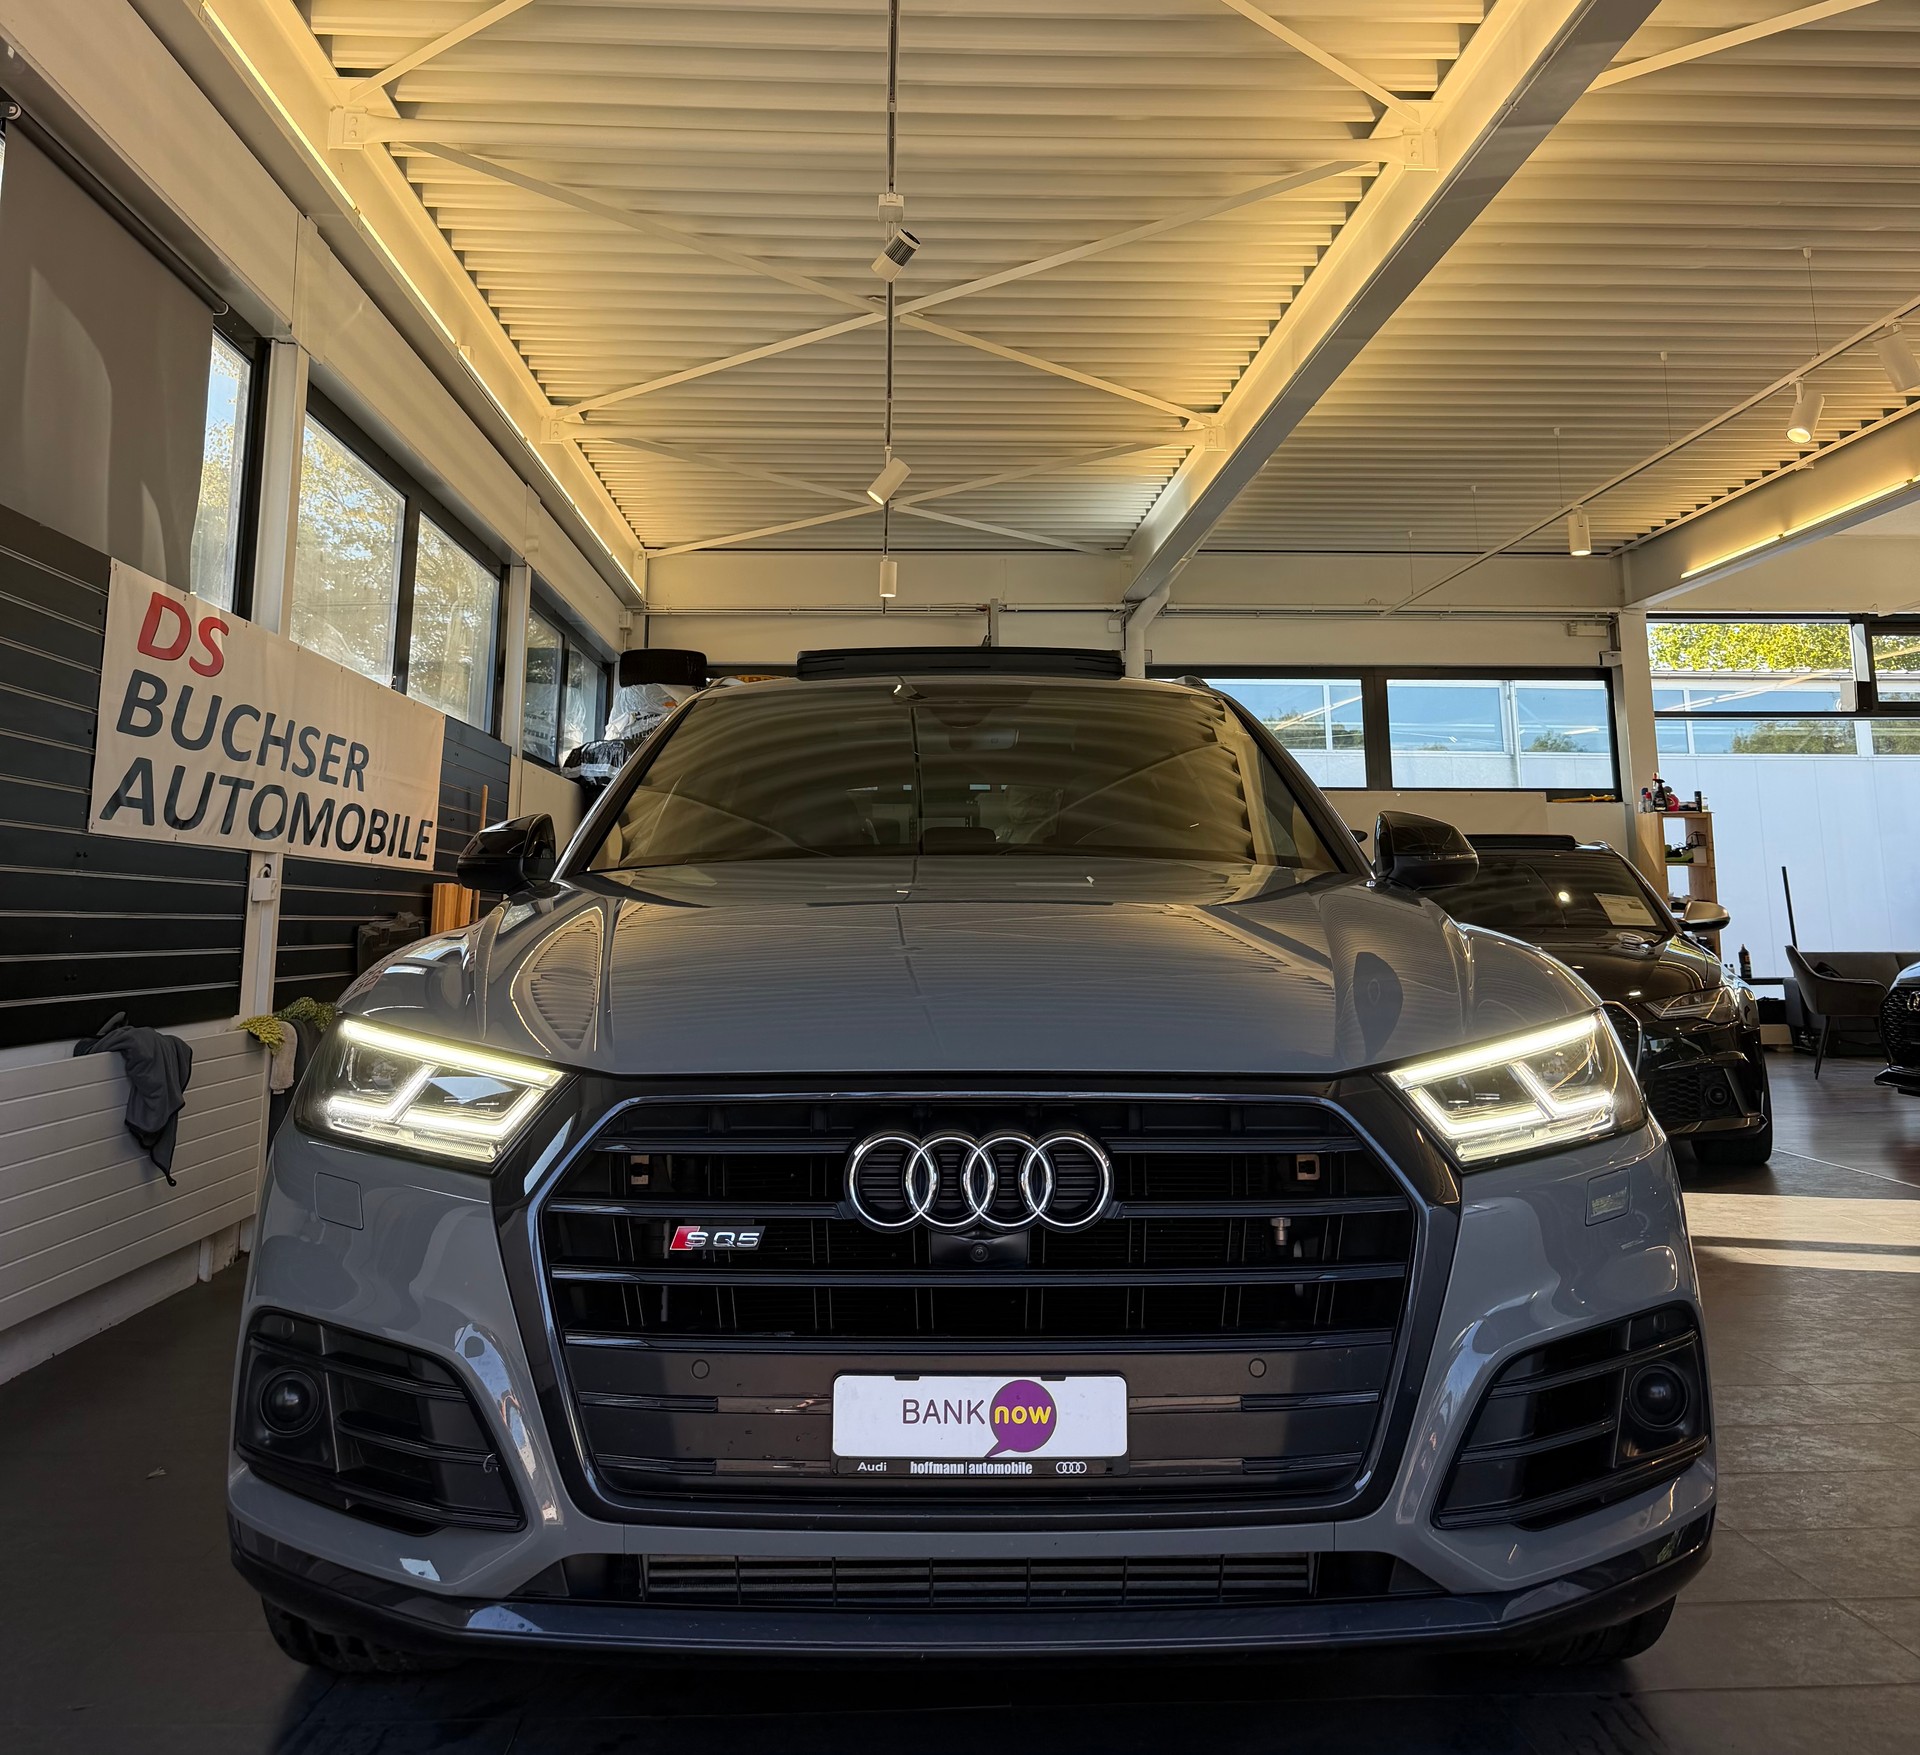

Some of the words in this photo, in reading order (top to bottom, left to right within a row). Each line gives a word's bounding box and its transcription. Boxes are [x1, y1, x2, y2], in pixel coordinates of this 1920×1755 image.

[137, 592, 229, 677] DS
[116, 669, 370, 792] BUCHSER
[99, 757, 434, 861] AUTOMOBILE
[685, 1231, 760, 1248] SQ5
[902, 1399, 985, 1424] BANK
[994, 1405, 1051, 1424] now
[857, 1461, 887, 1472] Audi
